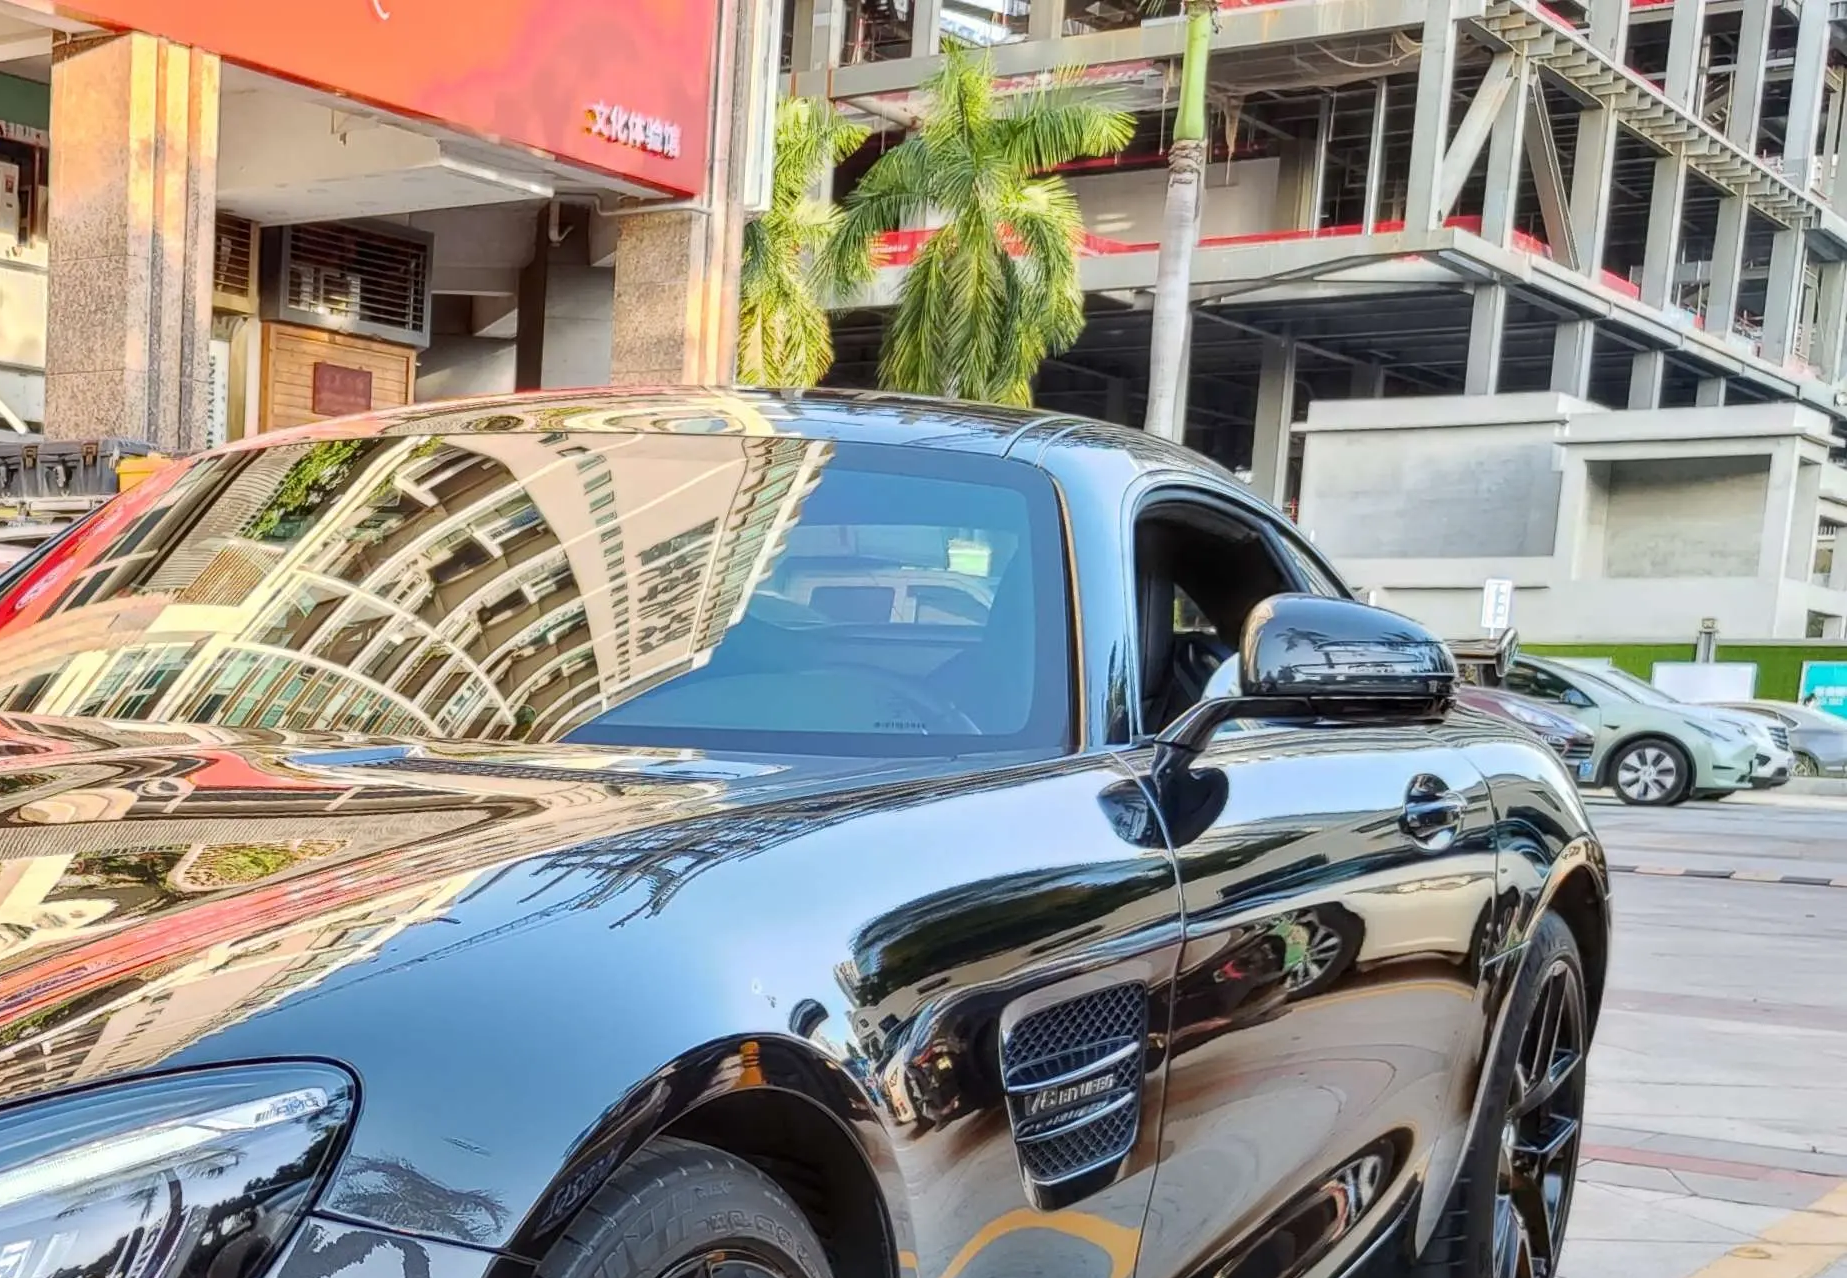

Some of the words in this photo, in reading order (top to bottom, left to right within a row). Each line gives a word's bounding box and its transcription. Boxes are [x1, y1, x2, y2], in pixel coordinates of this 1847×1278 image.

[591, 100, 682, 158] 文化体验馆
